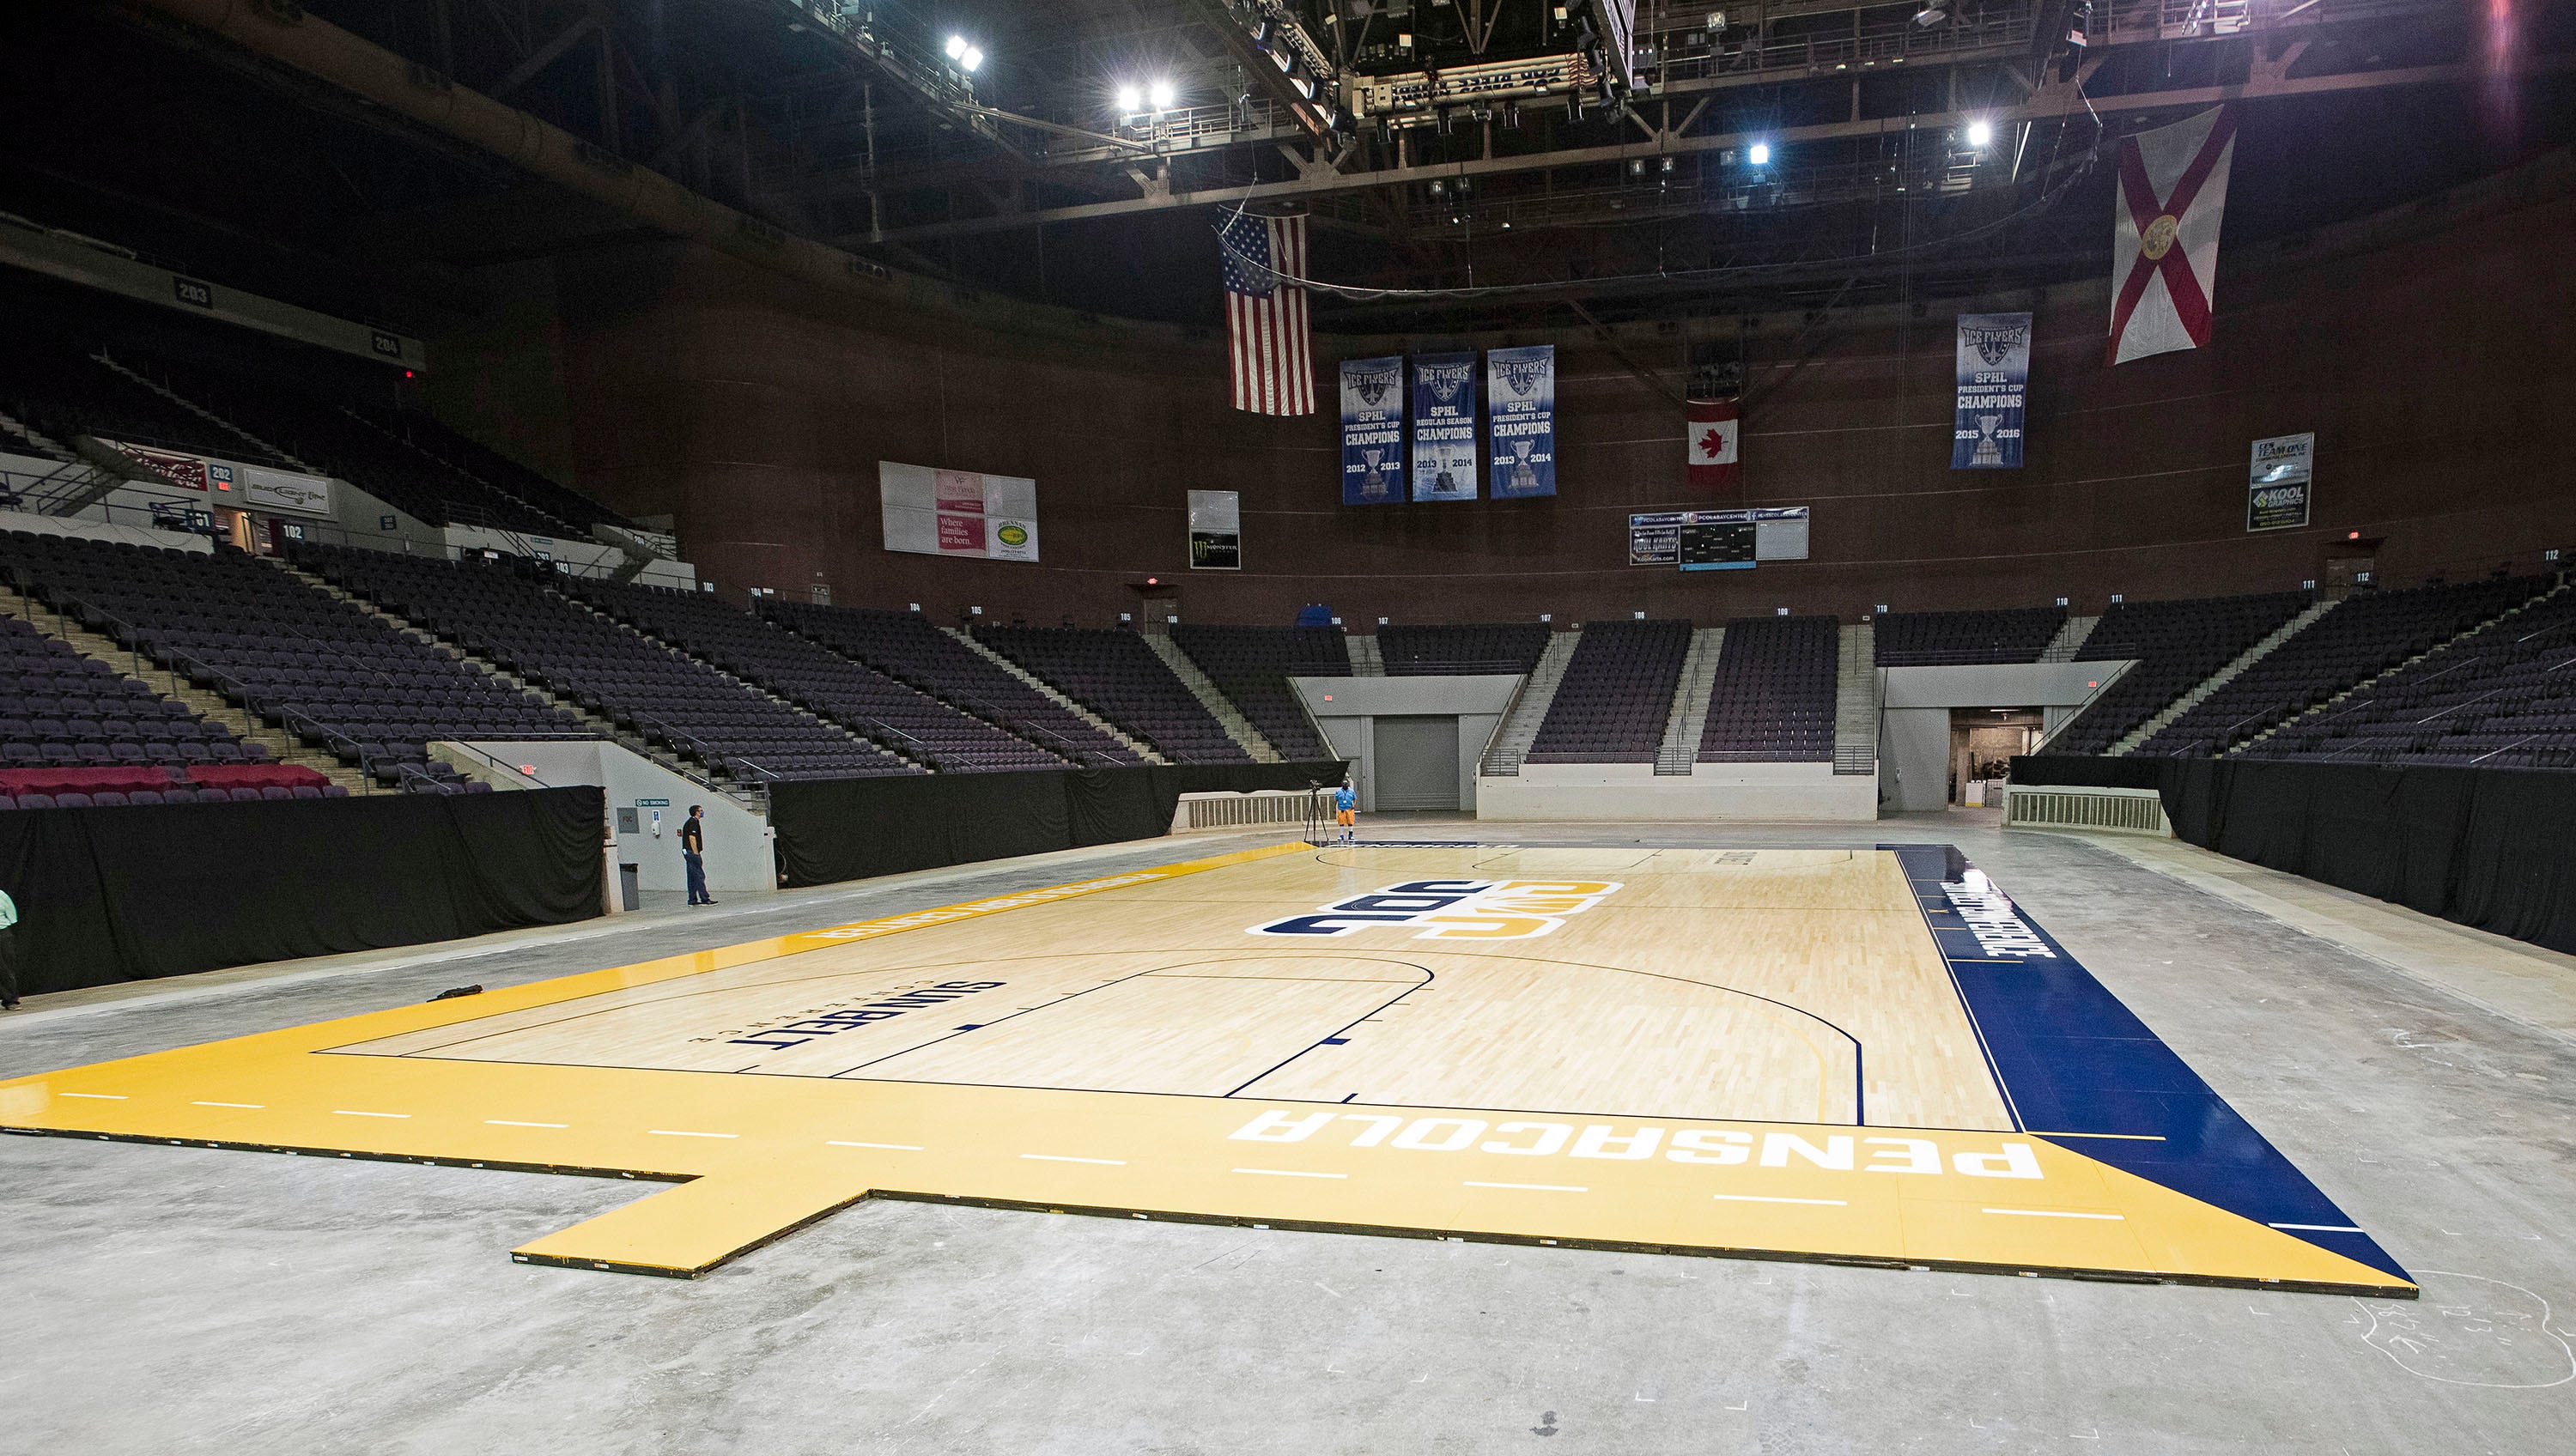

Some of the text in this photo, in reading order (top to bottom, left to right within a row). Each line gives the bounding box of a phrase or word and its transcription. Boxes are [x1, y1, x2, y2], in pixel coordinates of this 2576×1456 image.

[179, 283, 208, 303] 203
[1965, 329, 2022, 345] ICE FLYERS
[375, 336, 398, 354] 204
[1496, 360, 1546, 377] ICE FLYERS
[1348, 372, 1396, 387] ICE FLYERS
[1419, 367, 1470, 382] ICE FLYERS
[1975, 372, 2008, 383] SPHL
[1507, 401, 1536, 412] SPHL
[1958, 395, 2022, 410] CHAMPIONS
[1358, 410, 1386, 422] SPHL
[1431, 406, 1458, 416] SPHL
[1492, 413, 1536, 422] PRESIDENT'S
[1345, 422, 1386, 432] PRESIDENT'S
[1493, 422, 1551, 437] CHAMPIONS
[1346, 431, 1400, 446] CHAMPIONS
[1417, 427, 1473, 441] CHAMPIONS
[1955, 429, 2020, 439] 2015 2016
[1417, 458, 1473, 469] 2013 2014
[1494, 453, 1552, 465] 2013 2014
[1346, 462, 1400, 473] 2012 2013
[212, 466, 231, 481] 202
[2268, 486, 2304, 501] KOOL
[2268, 496, 2304, 507] GRAPHICS
[940, 518, 963, 527] Where
[283, 525, 302, 539] 102
[941, 526, 969, 536] families
[954, 537, 972, 545] born.
[2545, 549, 2559, 561] 112
[556, 562, 569, 573] 103
[2357, 572, 2370, 582] 112
[703, 582, 714, 592] 103
[2303, 579, 2315, 589] 111
[2057, 597, 2068, 606] 110
[2111, 594, 2123, 603] 111
[909, 603, 920, 612] 104
[971, 605, 982, 616] 105
[1876, 604, 1887, 613] 110
[1121, 612, 1131, 622] 105
[1378, 616, 1388, 625] 107
[1541, 614, 1552, 622] 107
[687, 980, 935, 1044] CONFERENCE
[726, 981, 1007, 1051] SUN BELT
[1227, 1108, 2044, 1180] PENSACOLA
